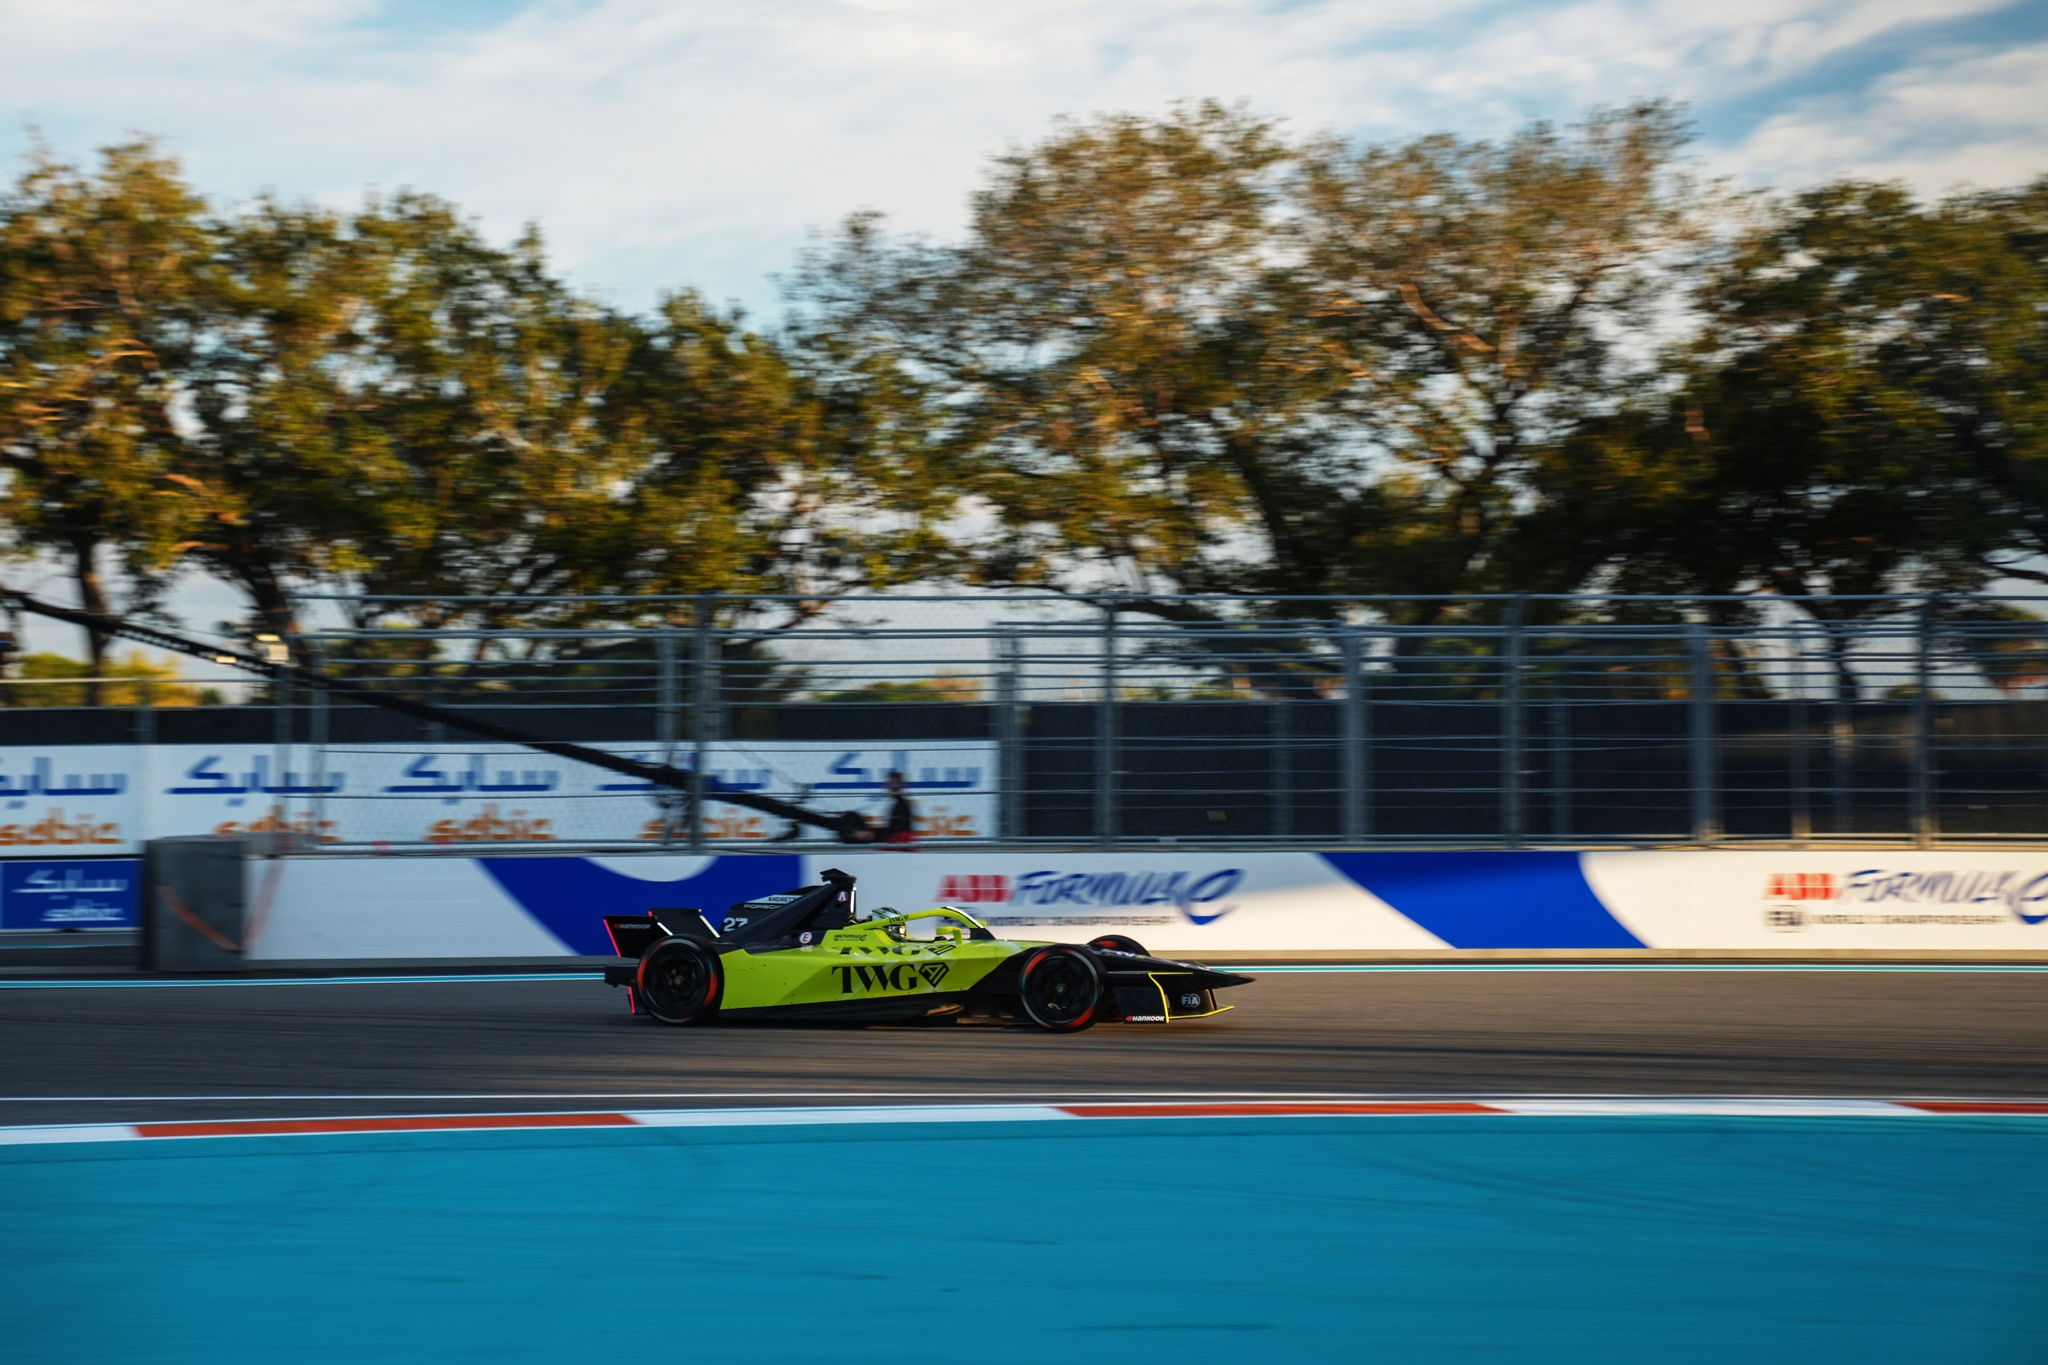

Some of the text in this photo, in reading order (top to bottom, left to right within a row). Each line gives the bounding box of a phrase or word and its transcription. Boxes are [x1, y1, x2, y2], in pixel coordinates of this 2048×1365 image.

[936, 874, 1014, 902] ABB
[1763, 872, 1841, 900] ABB
[723, 917, 748, 932] 27
[802, 933, 809, 942] E
[832, 964, 918, 993] TWG
